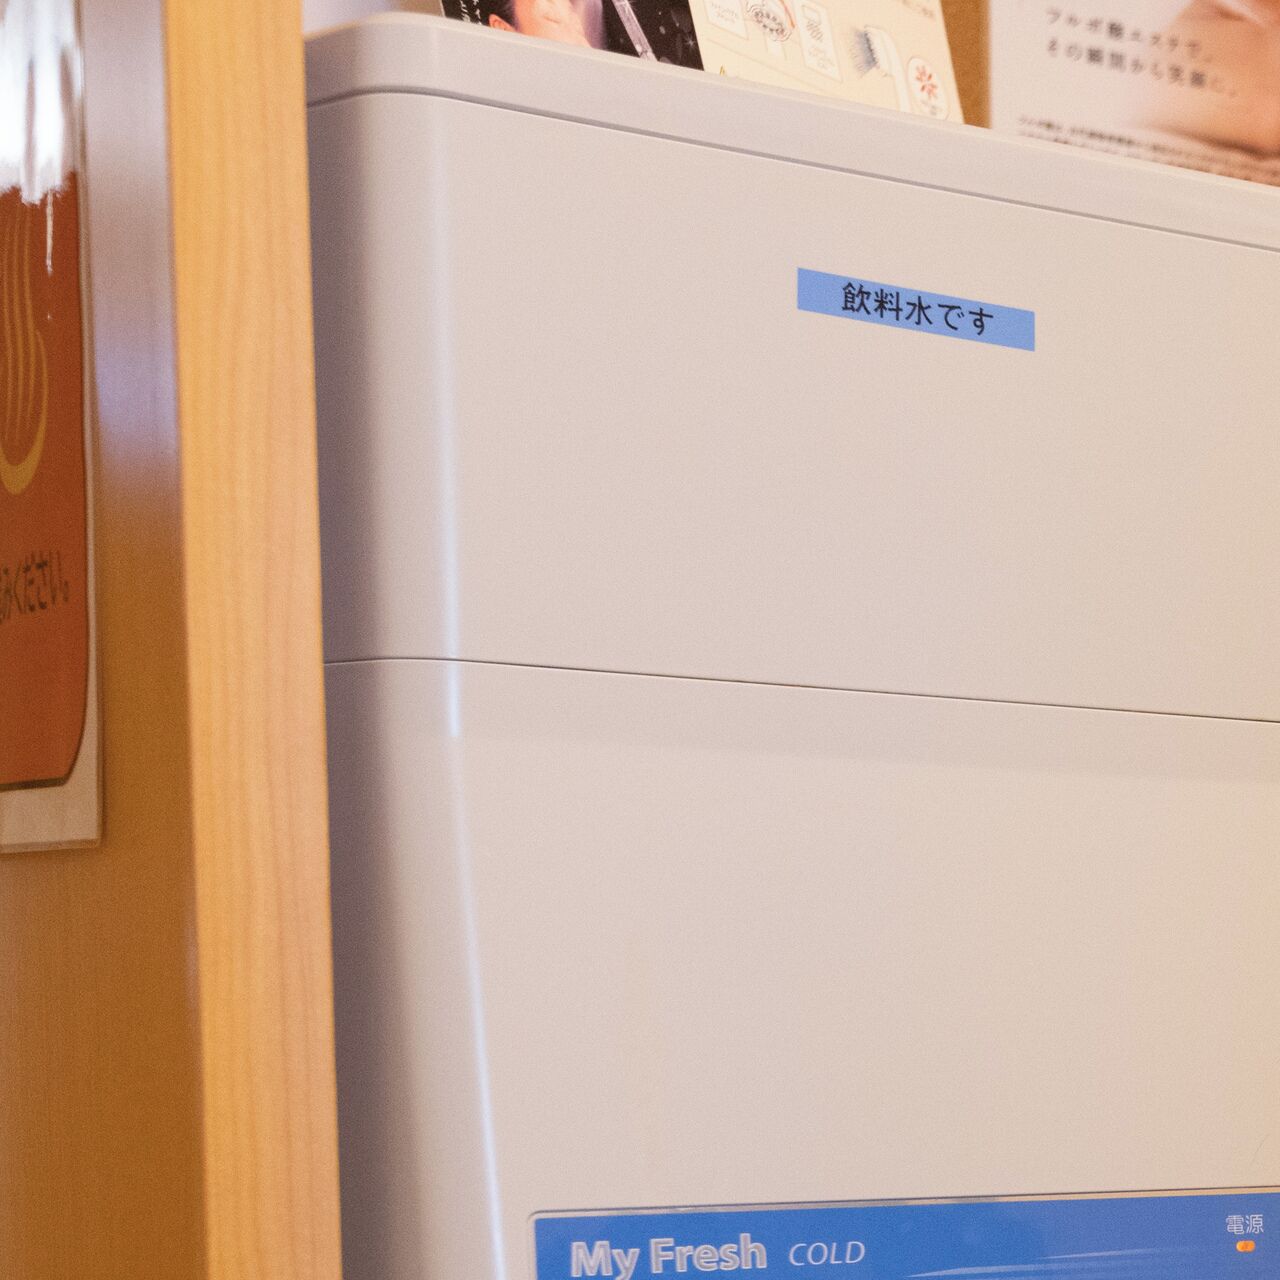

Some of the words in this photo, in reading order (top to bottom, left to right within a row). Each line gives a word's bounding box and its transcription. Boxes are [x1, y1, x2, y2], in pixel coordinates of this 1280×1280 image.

[840, 280, 995, 336] 飲料水です
[1225, 1213, 1265, 1235] 電源
[650, 1232, 768, 1275] Fresh
[788, 1240, 867, 1268] COLD
